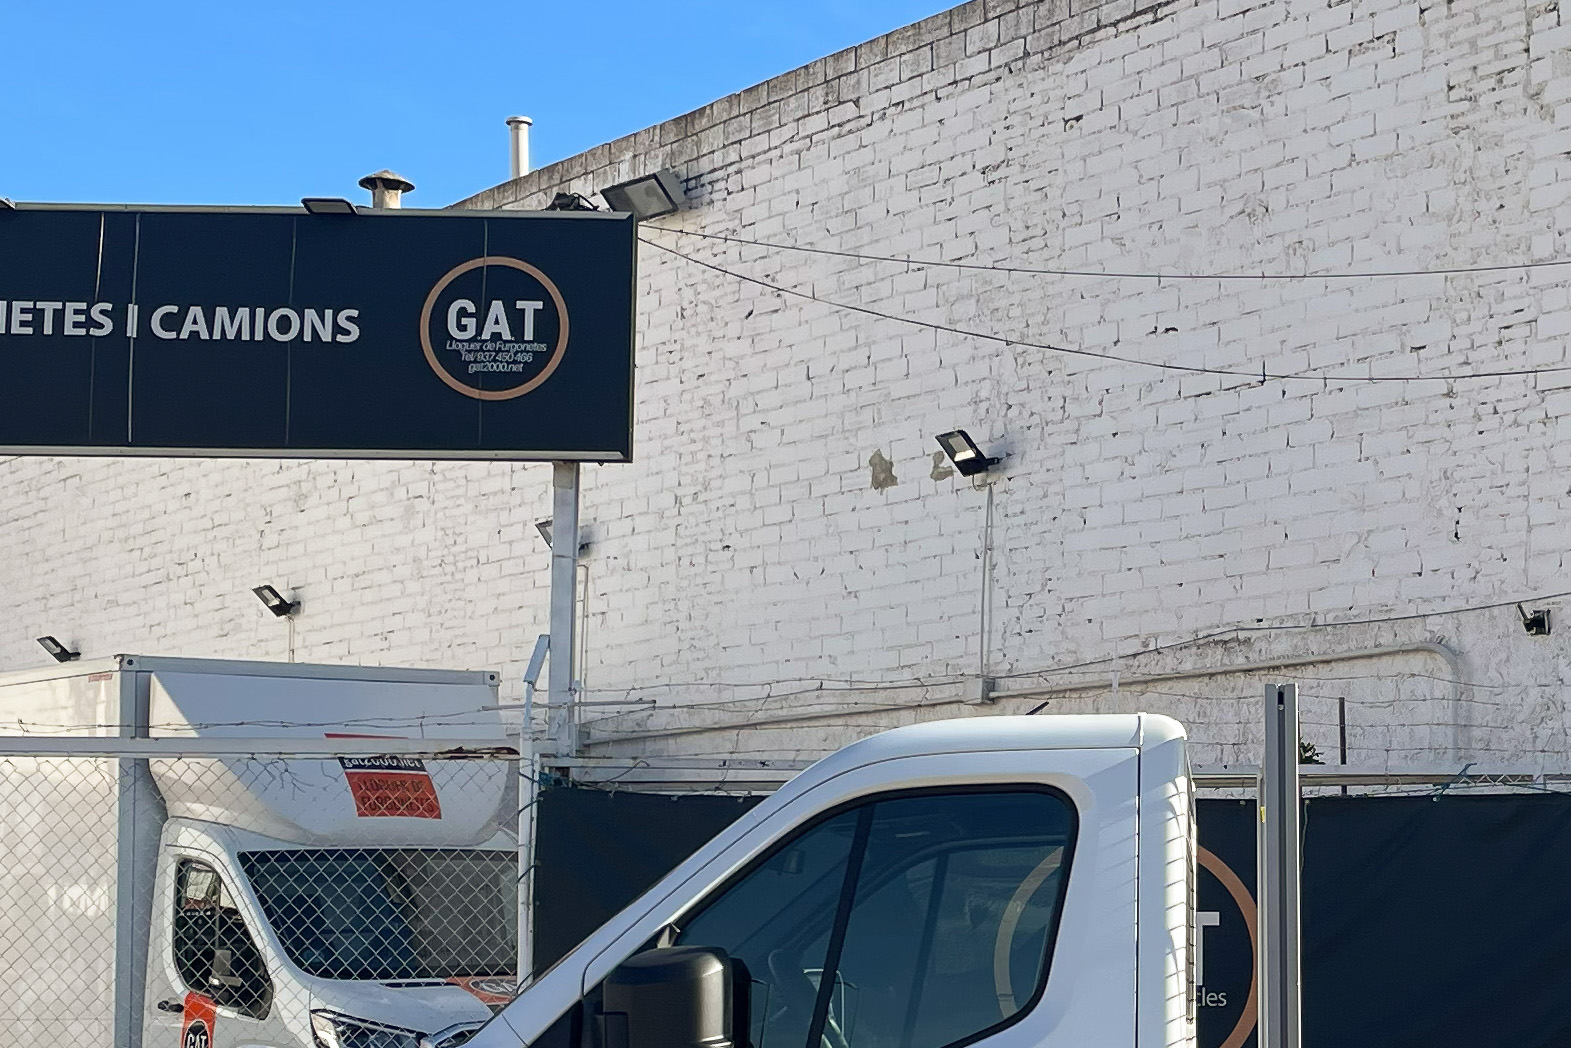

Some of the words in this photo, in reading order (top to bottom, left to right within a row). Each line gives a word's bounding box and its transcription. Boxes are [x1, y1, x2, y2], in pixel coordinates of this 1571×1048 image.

[150, 305, 360, 343] CAMIONS
[446, 341, 481, 352] Lloguer
[483, 341, 496, 351] de
[477, 352, 495, 362] 937
[496, 353, 514, 362] 450
[515, 353, 533, 362] 466
[468, 363, 524, 374] gat2000.net
